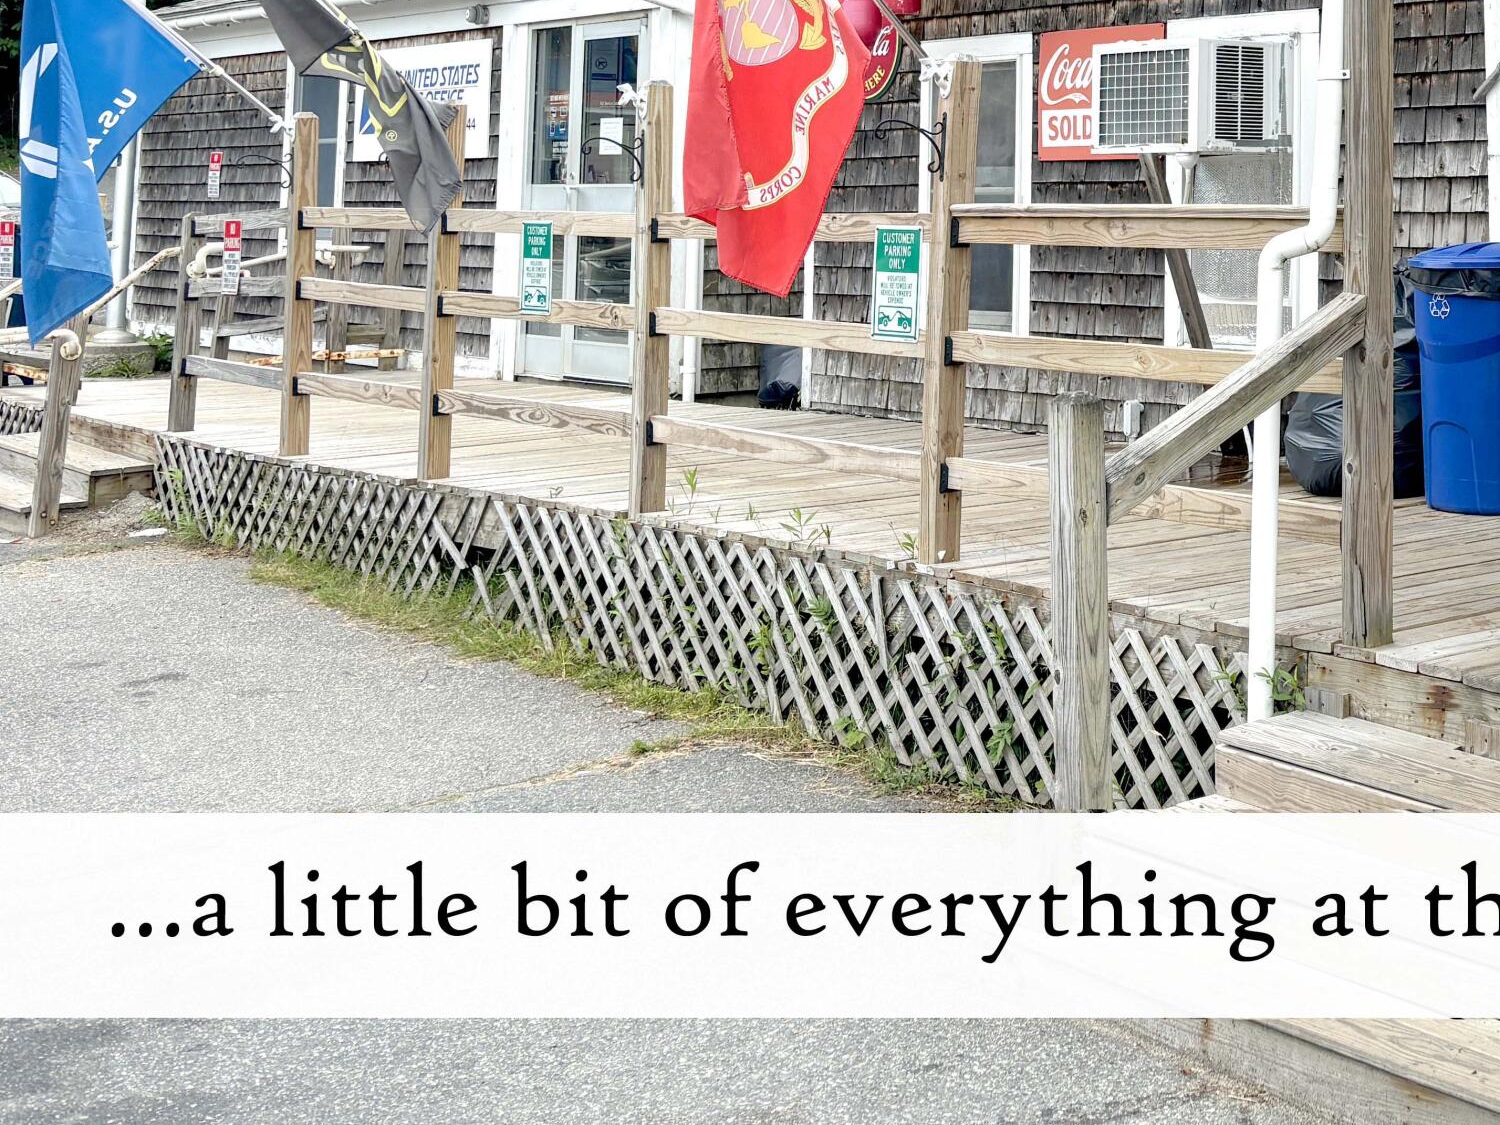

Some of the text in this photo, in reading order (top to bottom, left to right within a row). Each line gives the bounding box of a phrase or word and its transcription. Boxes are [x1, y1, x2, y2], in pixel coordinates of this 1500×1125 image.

[439, 62, 481, 87] STATES
[1048, 114, 1092, 141] SOLD
[882, 232, 915, 244] CUSTOMER
[884, 245, 912, 257] PARKING
[888, 258, 906, 270] ONLY
